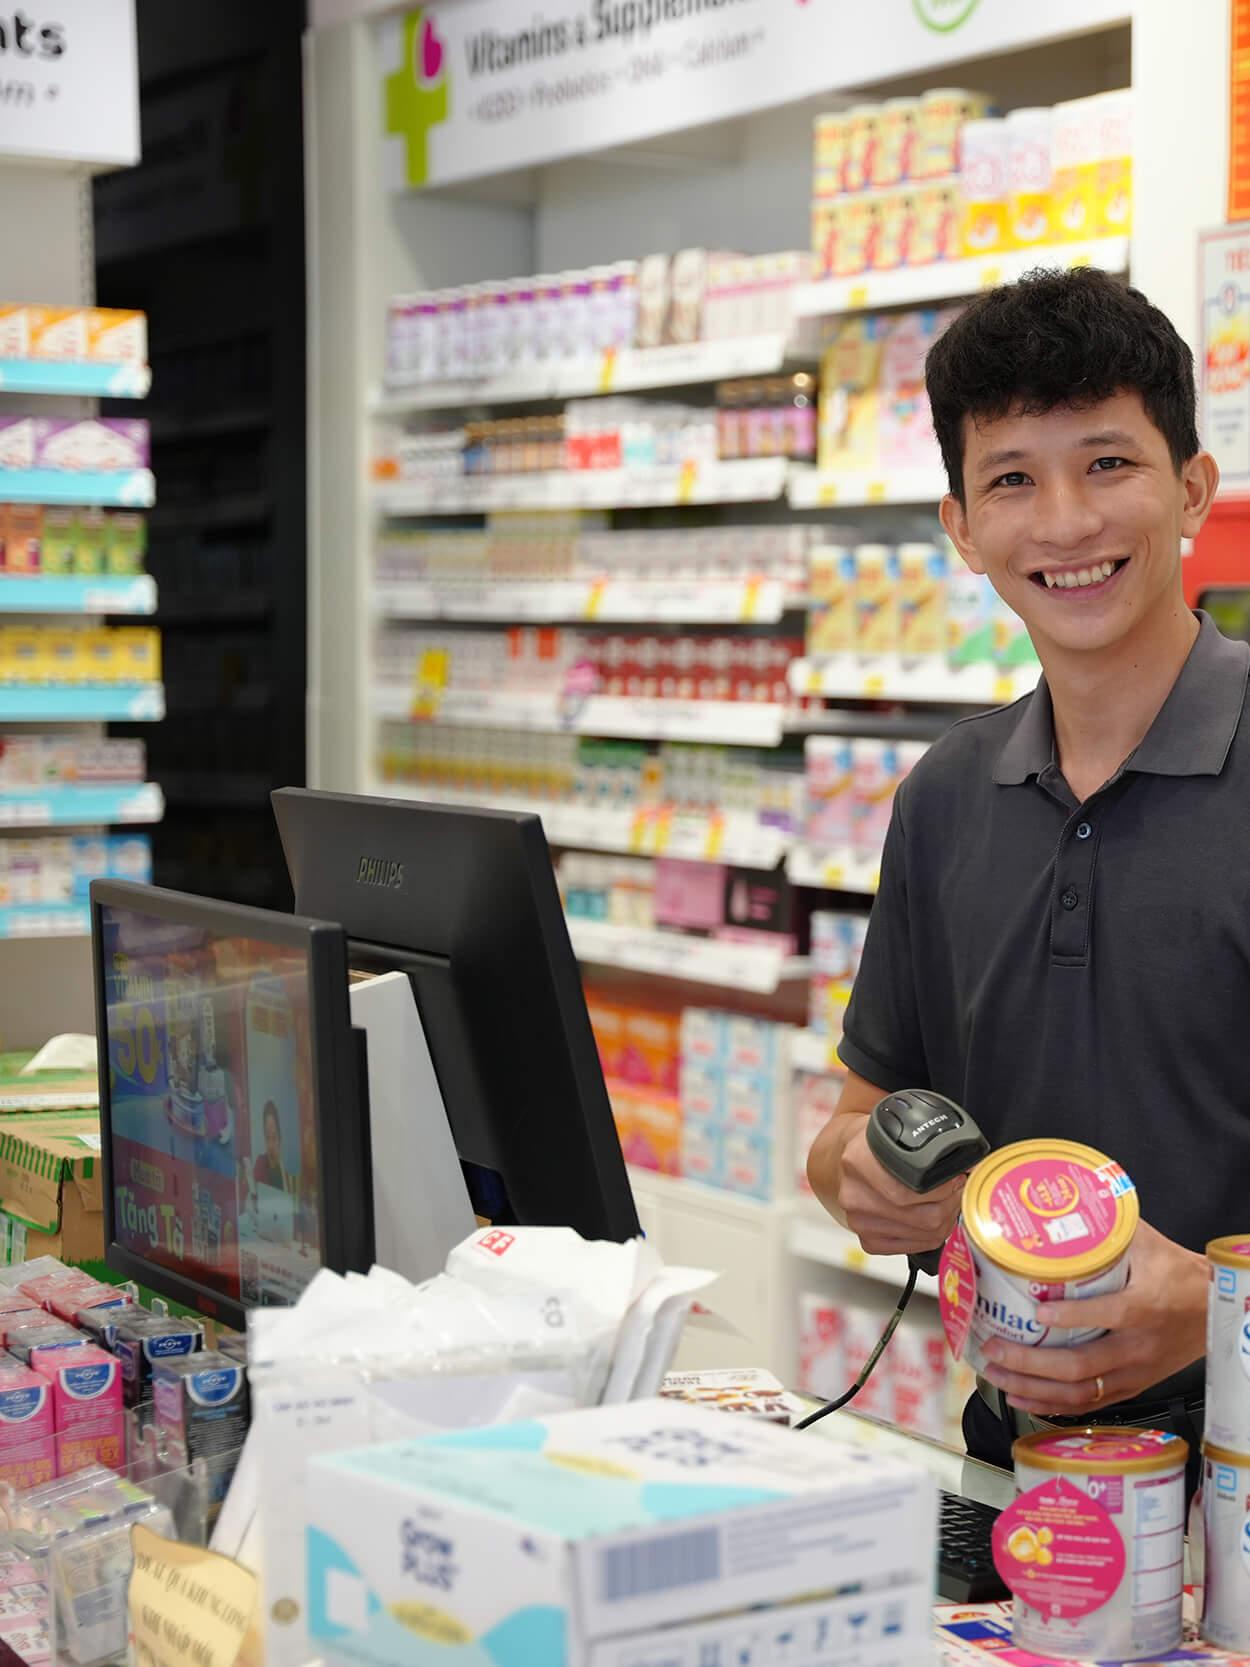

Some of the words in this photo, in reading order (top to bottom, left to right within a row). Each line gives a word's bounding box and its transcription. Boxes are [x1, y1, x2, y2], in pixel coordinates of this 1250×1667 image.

[0, 9, 66, 61] ts
[356, 855, 405, 890] PHILIPS
[912, 1114, 949, 1137] ANTECH
[114, 1186, 159, 1249] Tặng
